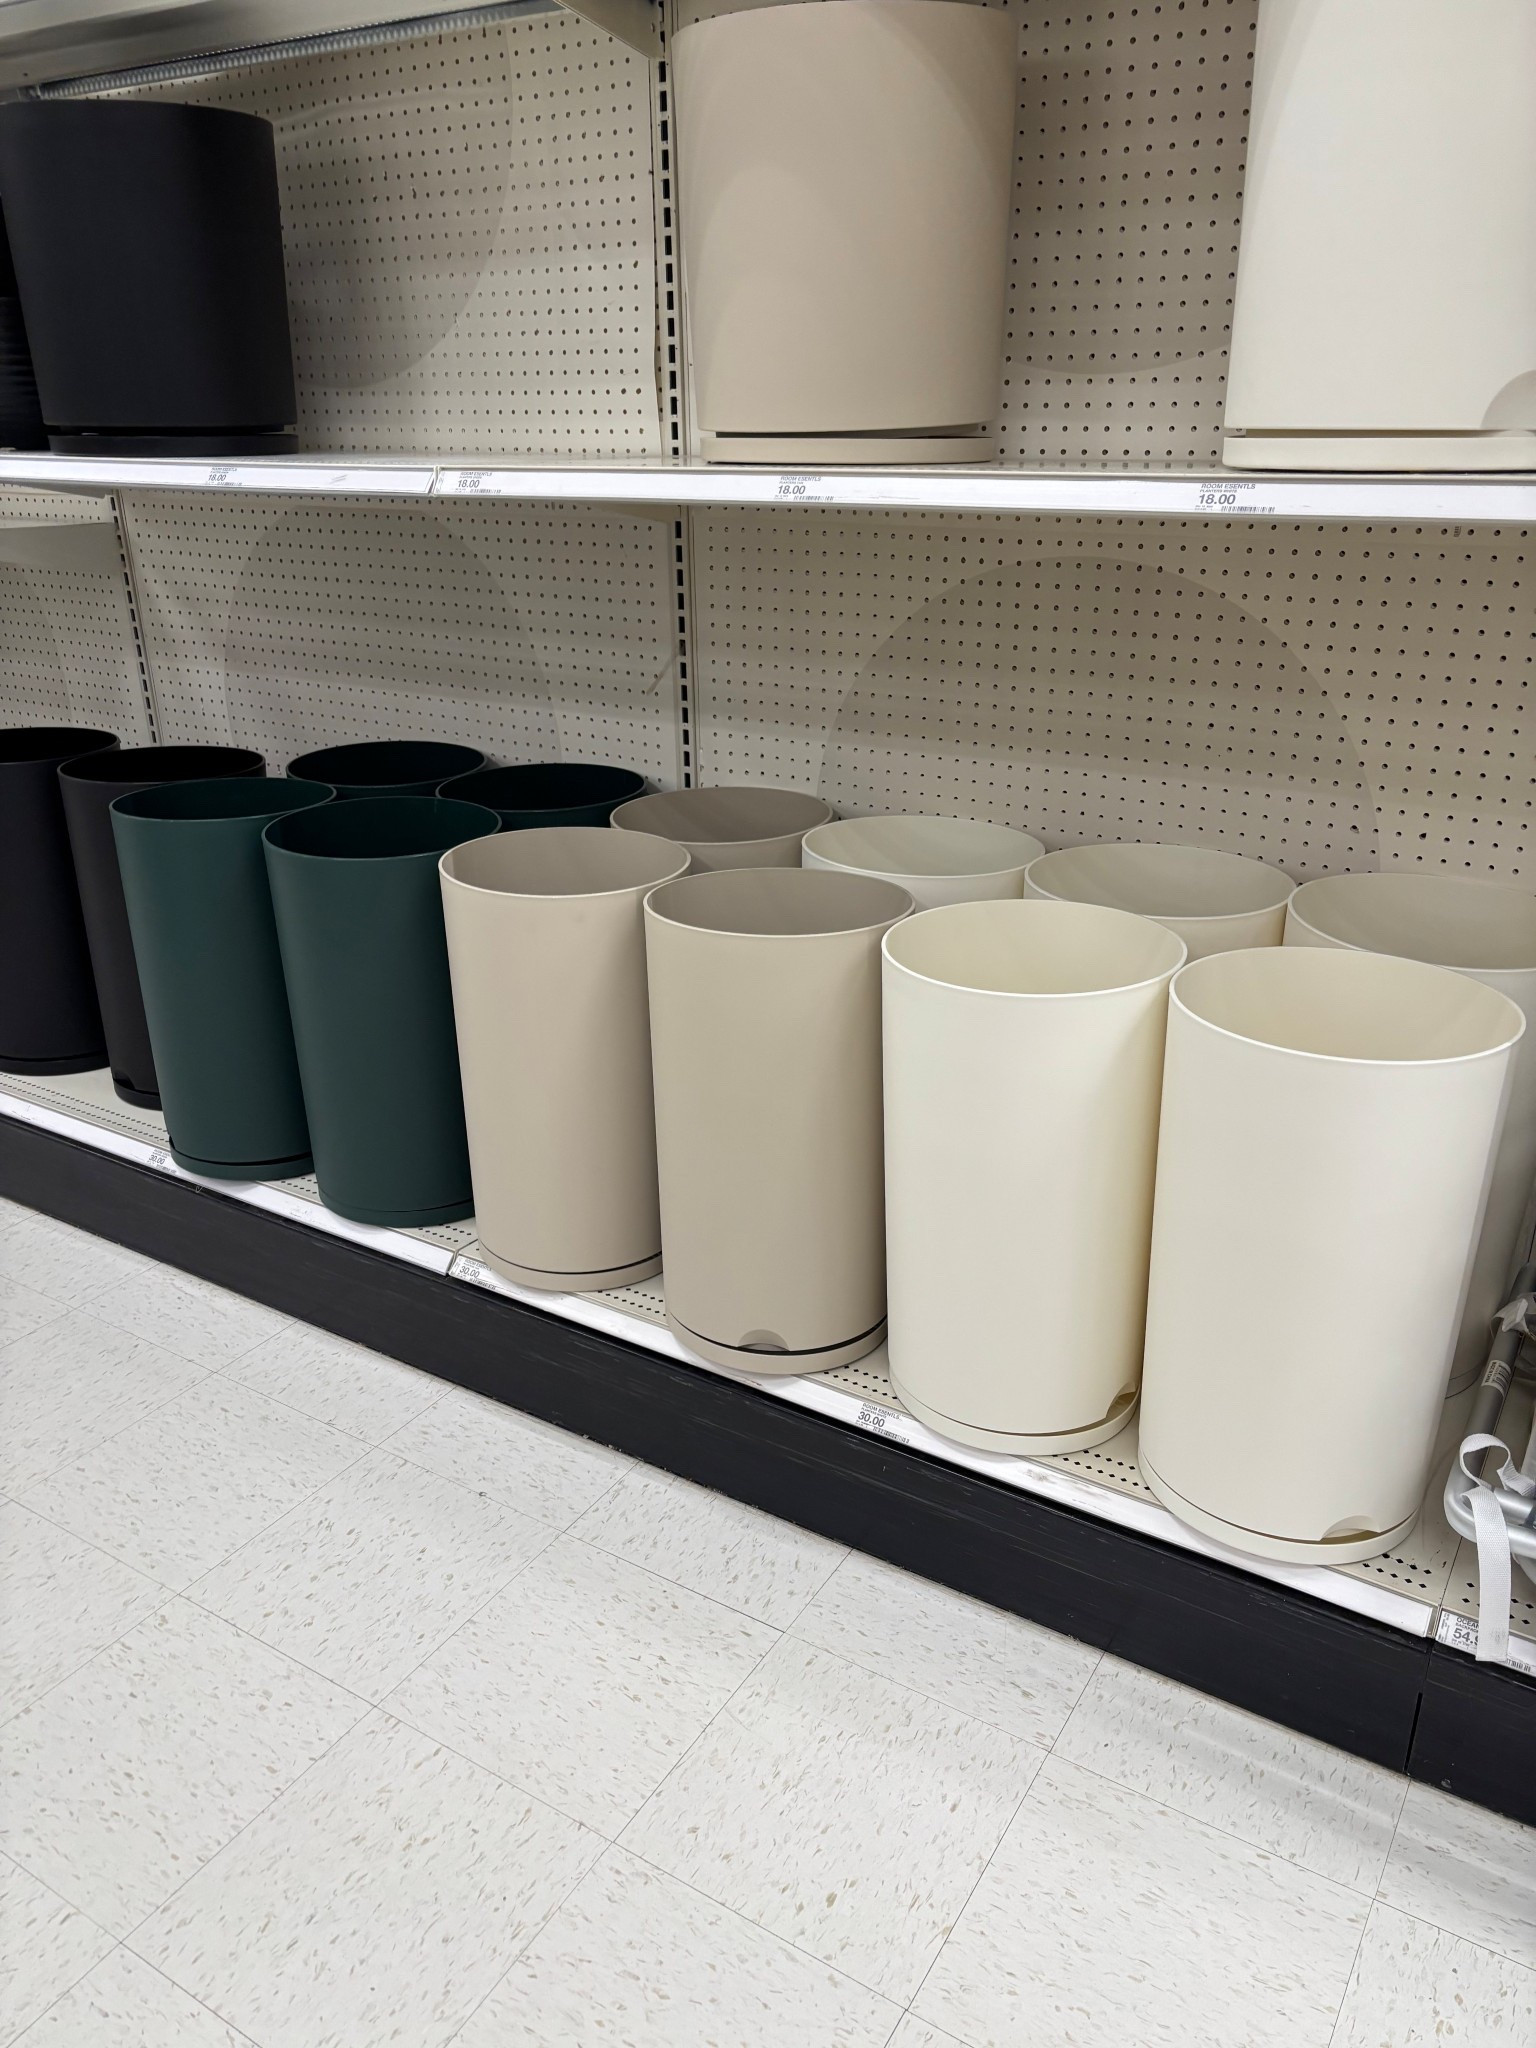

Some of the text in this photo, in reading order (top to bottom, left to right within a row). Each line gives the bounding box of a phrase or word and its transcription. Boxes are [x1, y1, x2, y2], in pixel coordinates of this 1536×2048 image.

[457, 479, 480, 488] 18.00
[778, 485, 806, 495] 18.00
[1199, 494, 1236, 505] 18.00
[149, 1155, 166, 1165] 30.00
[459, 1265, 480, 1279] 30.00
[862, 1402, 878, 1411] ROOM
[857, 1411, 885, 1428] 30.00
